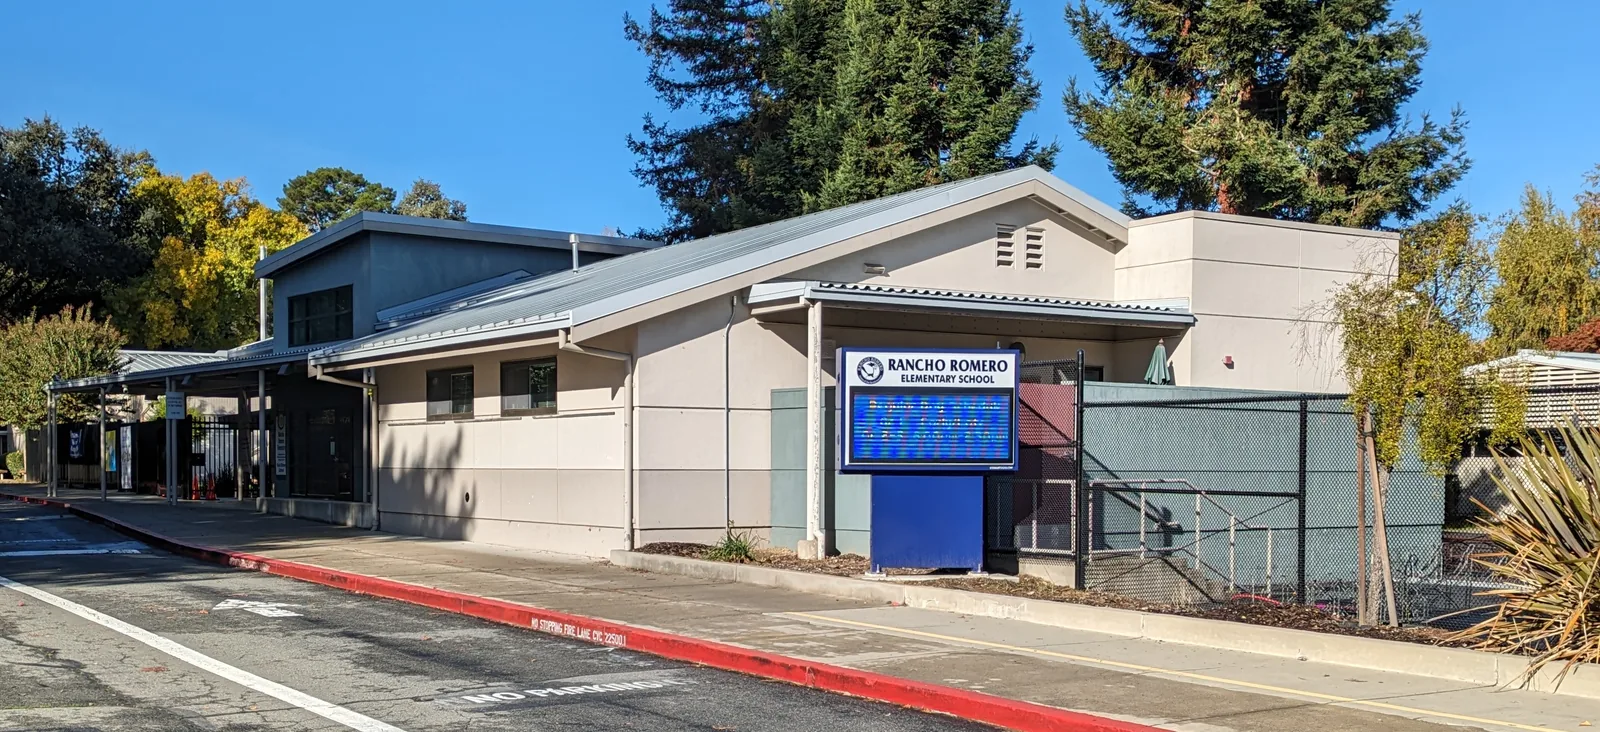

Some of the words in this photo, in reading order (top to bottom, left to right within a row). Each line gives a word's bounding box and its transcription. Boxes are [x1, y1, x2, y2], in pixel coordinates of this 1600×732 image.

[888, 358, 946, 372] RANCHO
[950, 359, 1008, 372] ROMERO
[901, 374, 956, 383] ELEMENTARY
[958, 375, 995, 384] SCHOOL
[531, 617, 539, 630] NO
[540, 619, 562, 633] STOPPING
[564, 624, 576, 636] FIRE
[577, 627, 591, 640] LANE
[460, 692, 525, 703] NO
[523, 681, 662, 697] PARKING
